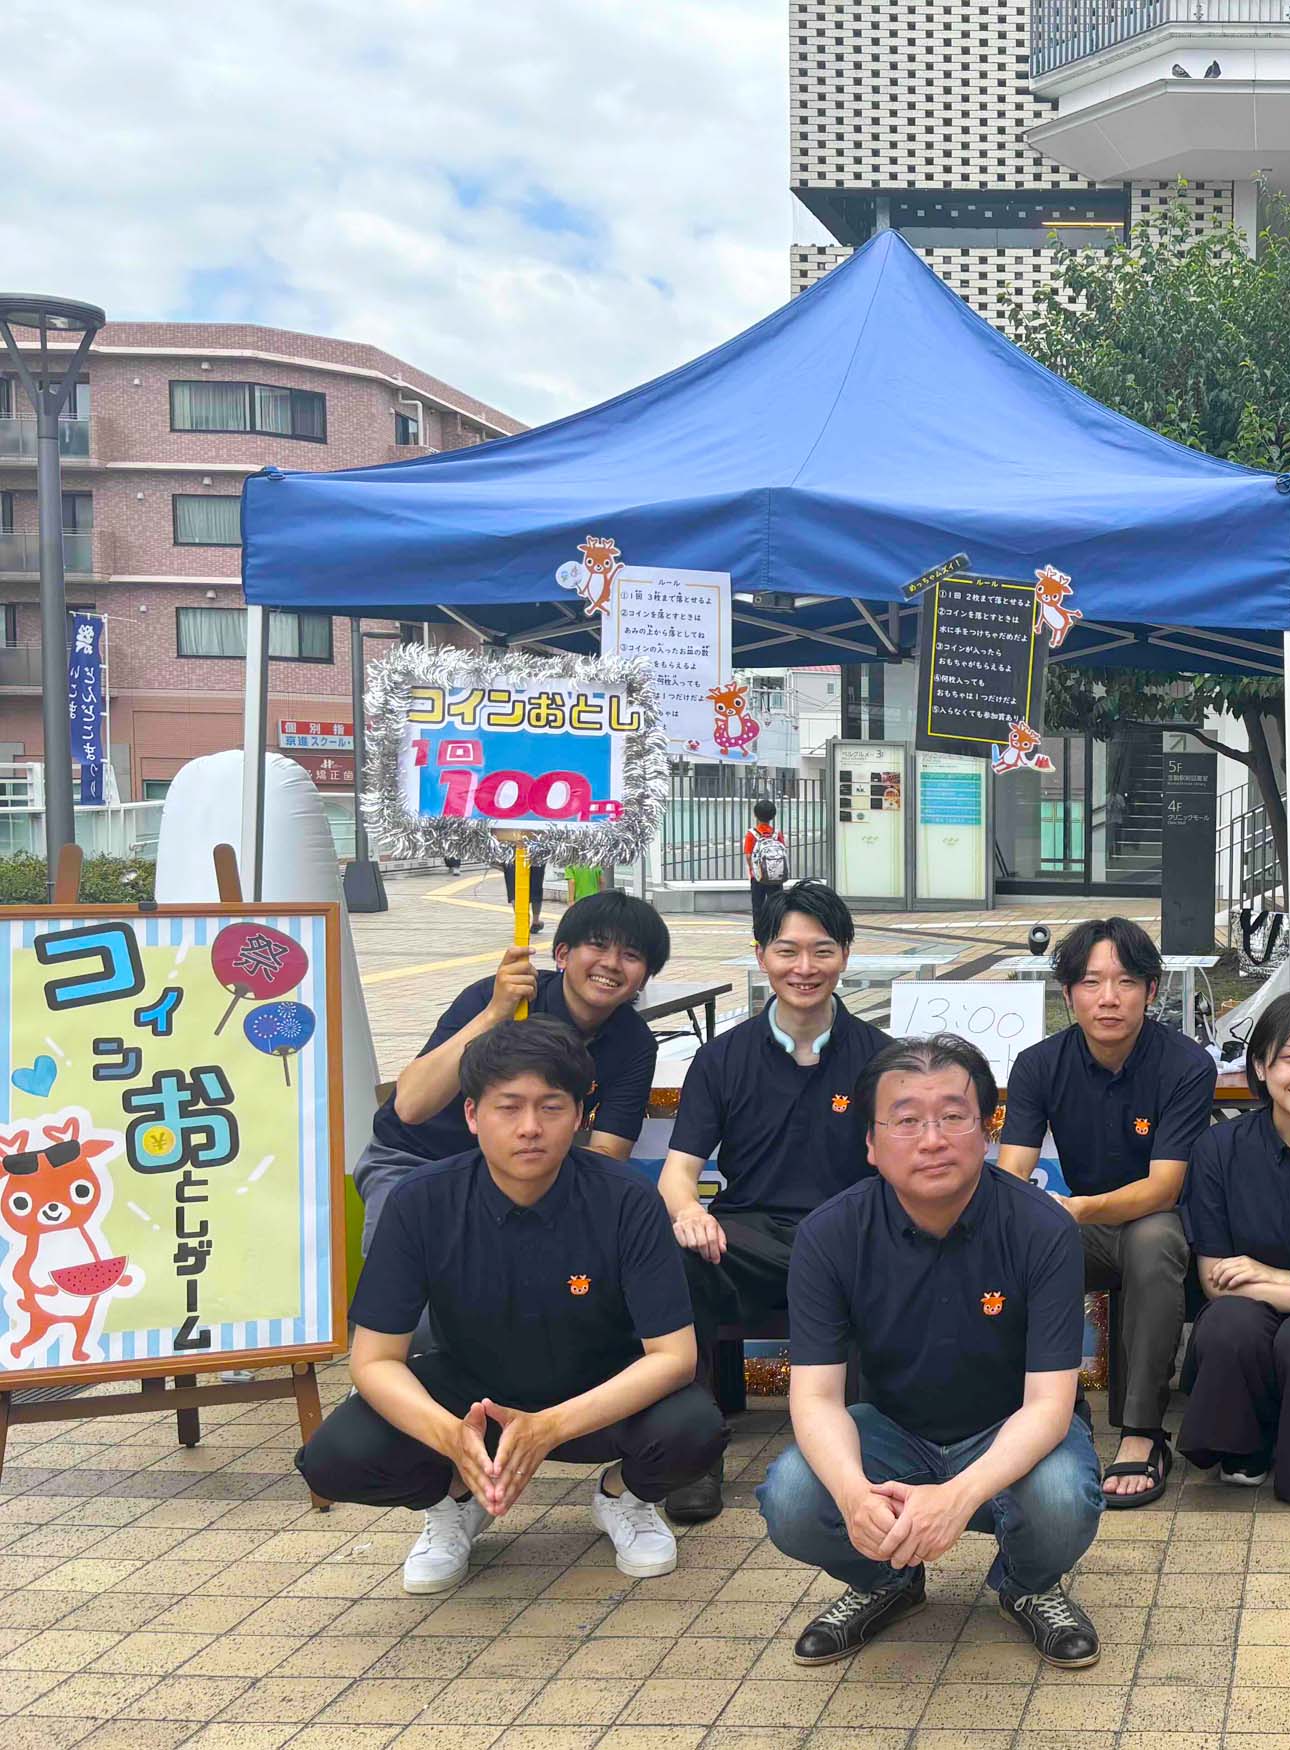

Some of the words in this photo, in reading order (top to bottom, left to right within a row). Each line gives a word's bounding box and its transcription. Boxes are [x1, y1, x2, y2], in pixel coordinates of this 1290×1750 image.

[976, 579, 999, 588] ルール
[285, 722, 346, 736] 個別指
[405, 685, 641, 731] コインおとし
[411, 739, 484, 767] 1回
[438, 769, 625, 822] 100円
[232, 934, 292, 983] 祭
[905, 996, 1025, 1038] 13:00
